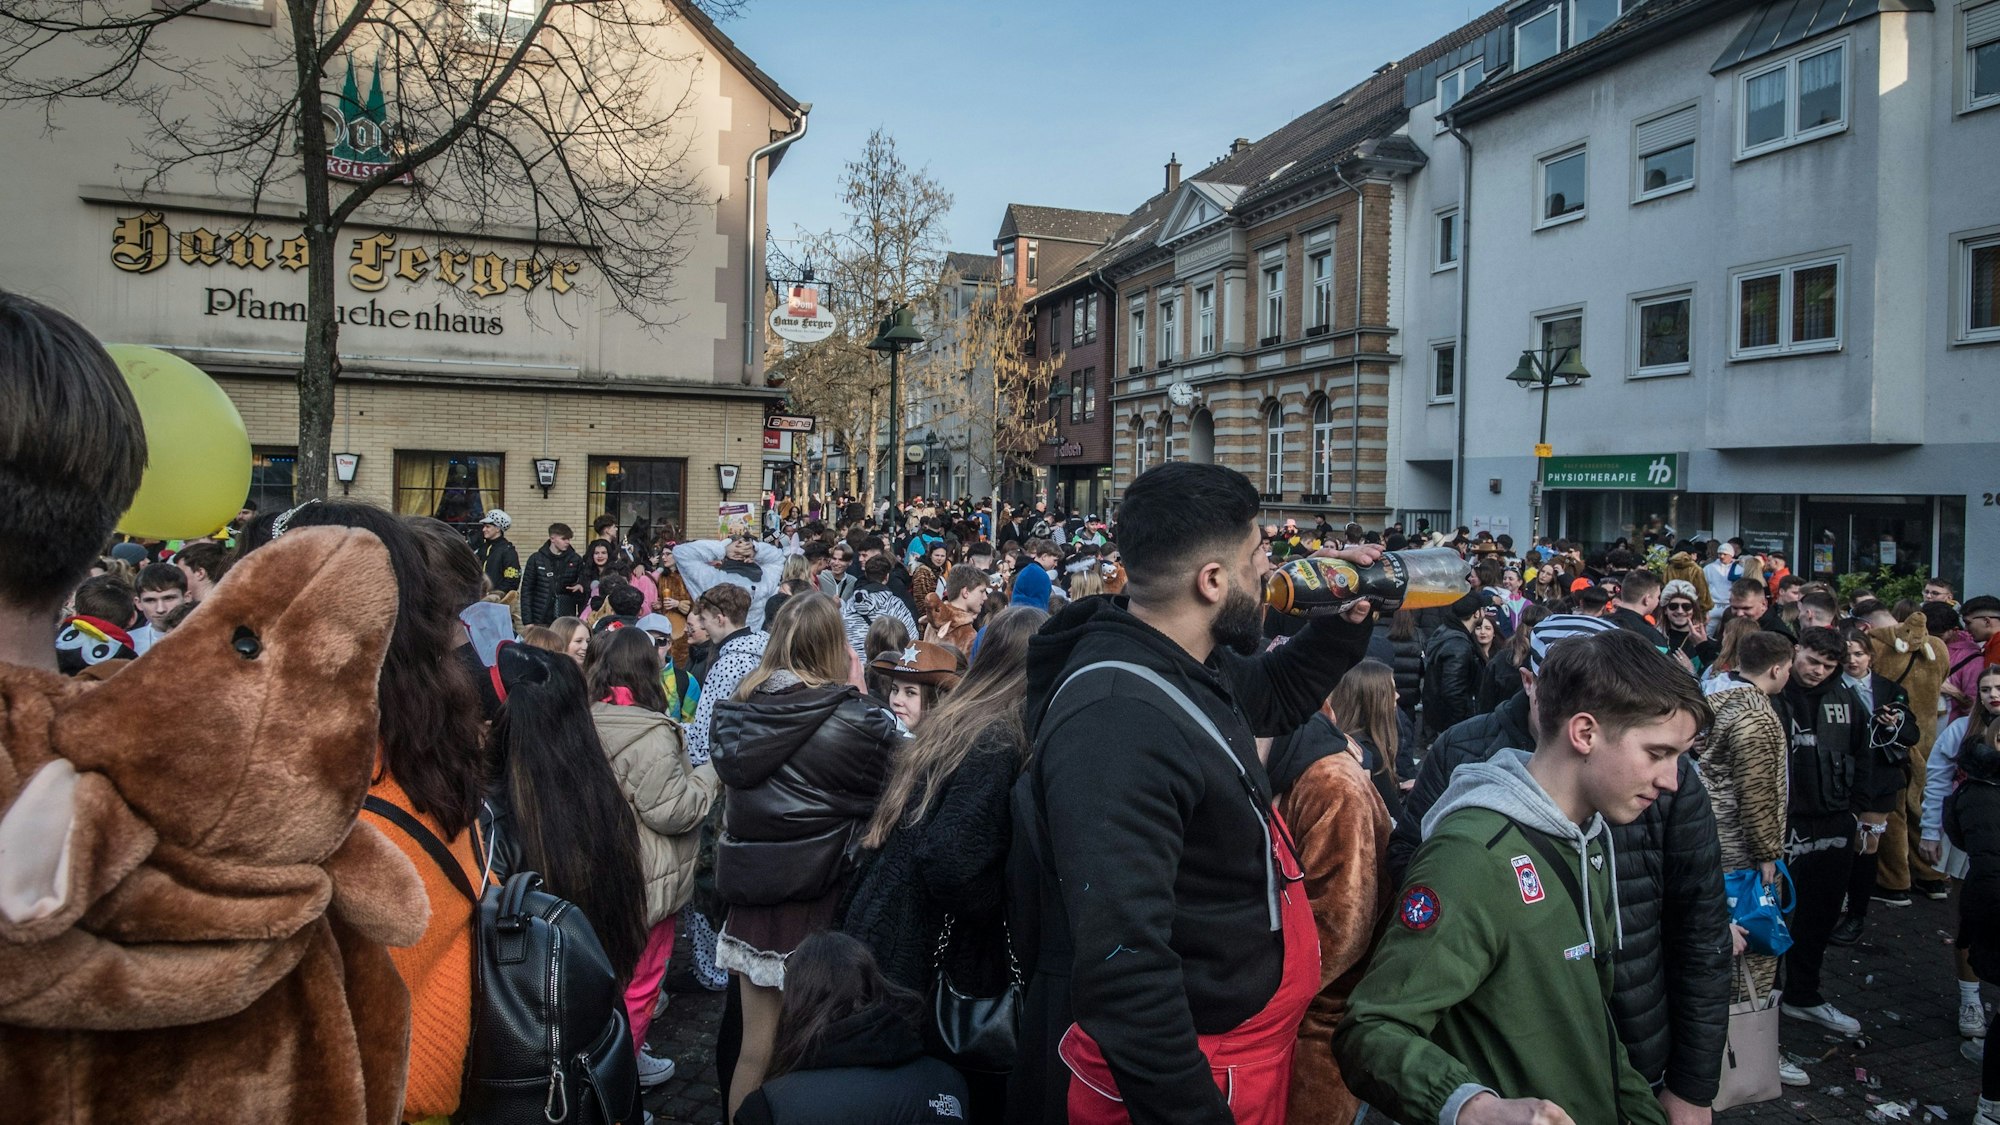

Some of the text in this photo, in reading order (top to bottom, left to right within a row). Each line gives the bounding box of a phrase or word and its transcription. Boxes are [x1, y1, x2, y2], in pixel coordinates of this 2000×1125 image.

[111, 210, 581, 298] Haus Ferger
[794, 300, 813, 310] Dom
[204, 287, 504, 336] Pfannuchenhaus
[773, 315, 833, 330] Haus Ferger
[770, 418, 811, 428] arena
[339, 458, 354, 466] Dom
[1548, 472, 1637, 482] PHYSIOTHERAPIE
[1823, 703, 1850, 724] FBI
[938, 1093, 952, 1101] THE
[928, 1099, 954, 1109] NORTH
[936, 1107, 955, 1117] FACE
